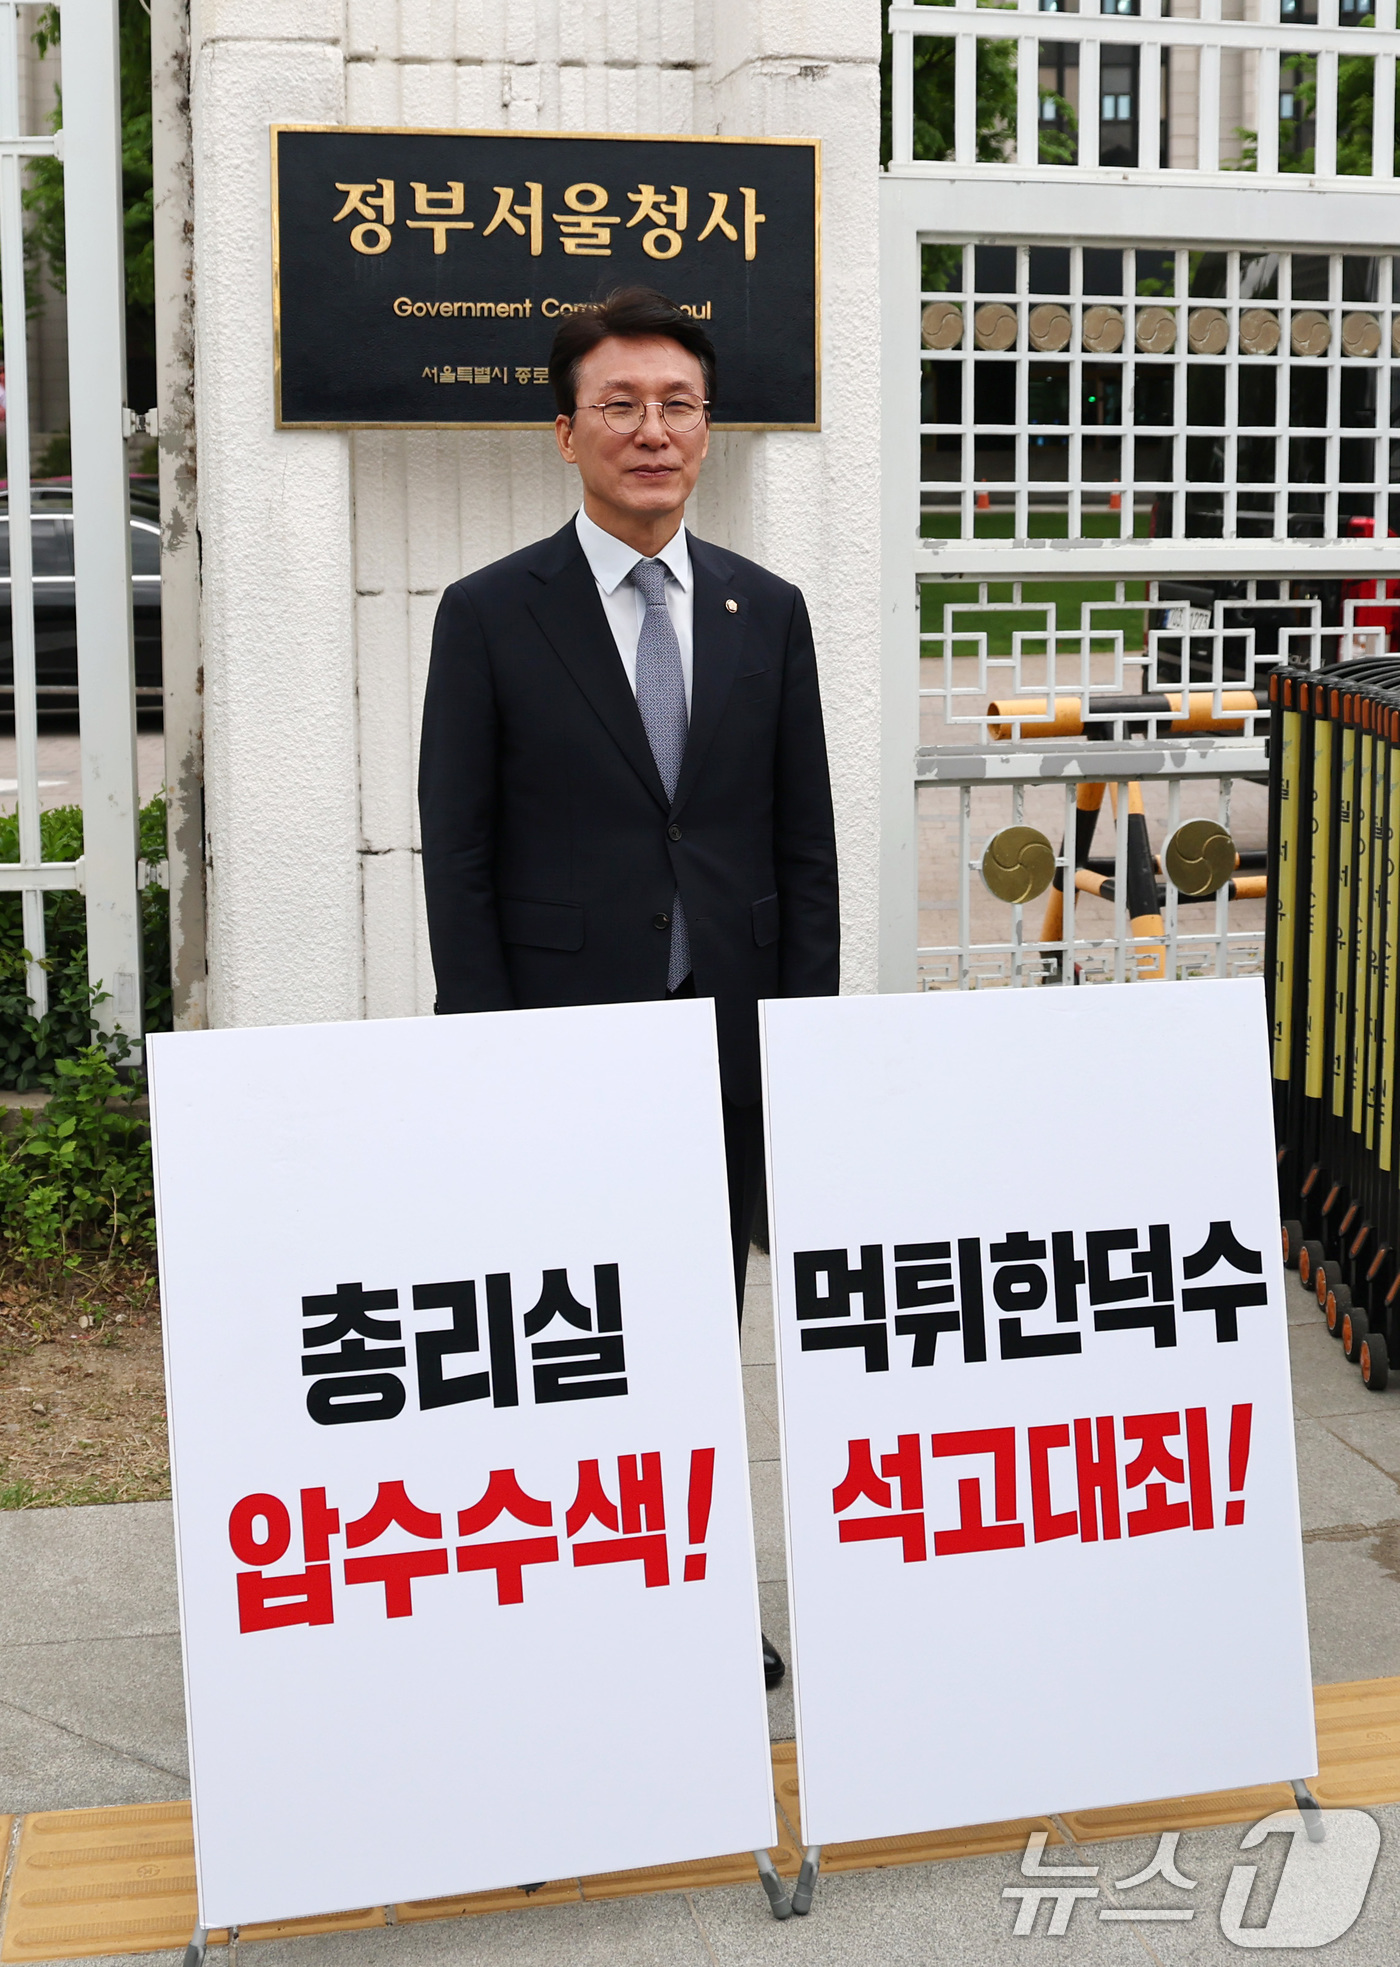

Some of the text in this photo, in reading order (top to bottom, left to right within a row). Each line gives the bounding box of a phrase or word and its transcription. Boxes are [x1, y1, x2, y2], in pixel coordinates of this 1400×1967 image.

[332, 178, 767, 262] 정부서울청사
[392, 296, 533, 318] Government
[421, 364, 549, 385] 서울특별시 종로
[301, 1262, 629, 1426] 총리실
[793, 1220, 1268, 1373] 먹튀한덕수
[228, 1447, 716, 1634] 압수수색!
[832, 1403, 1253, 1563] 석고대죄!
